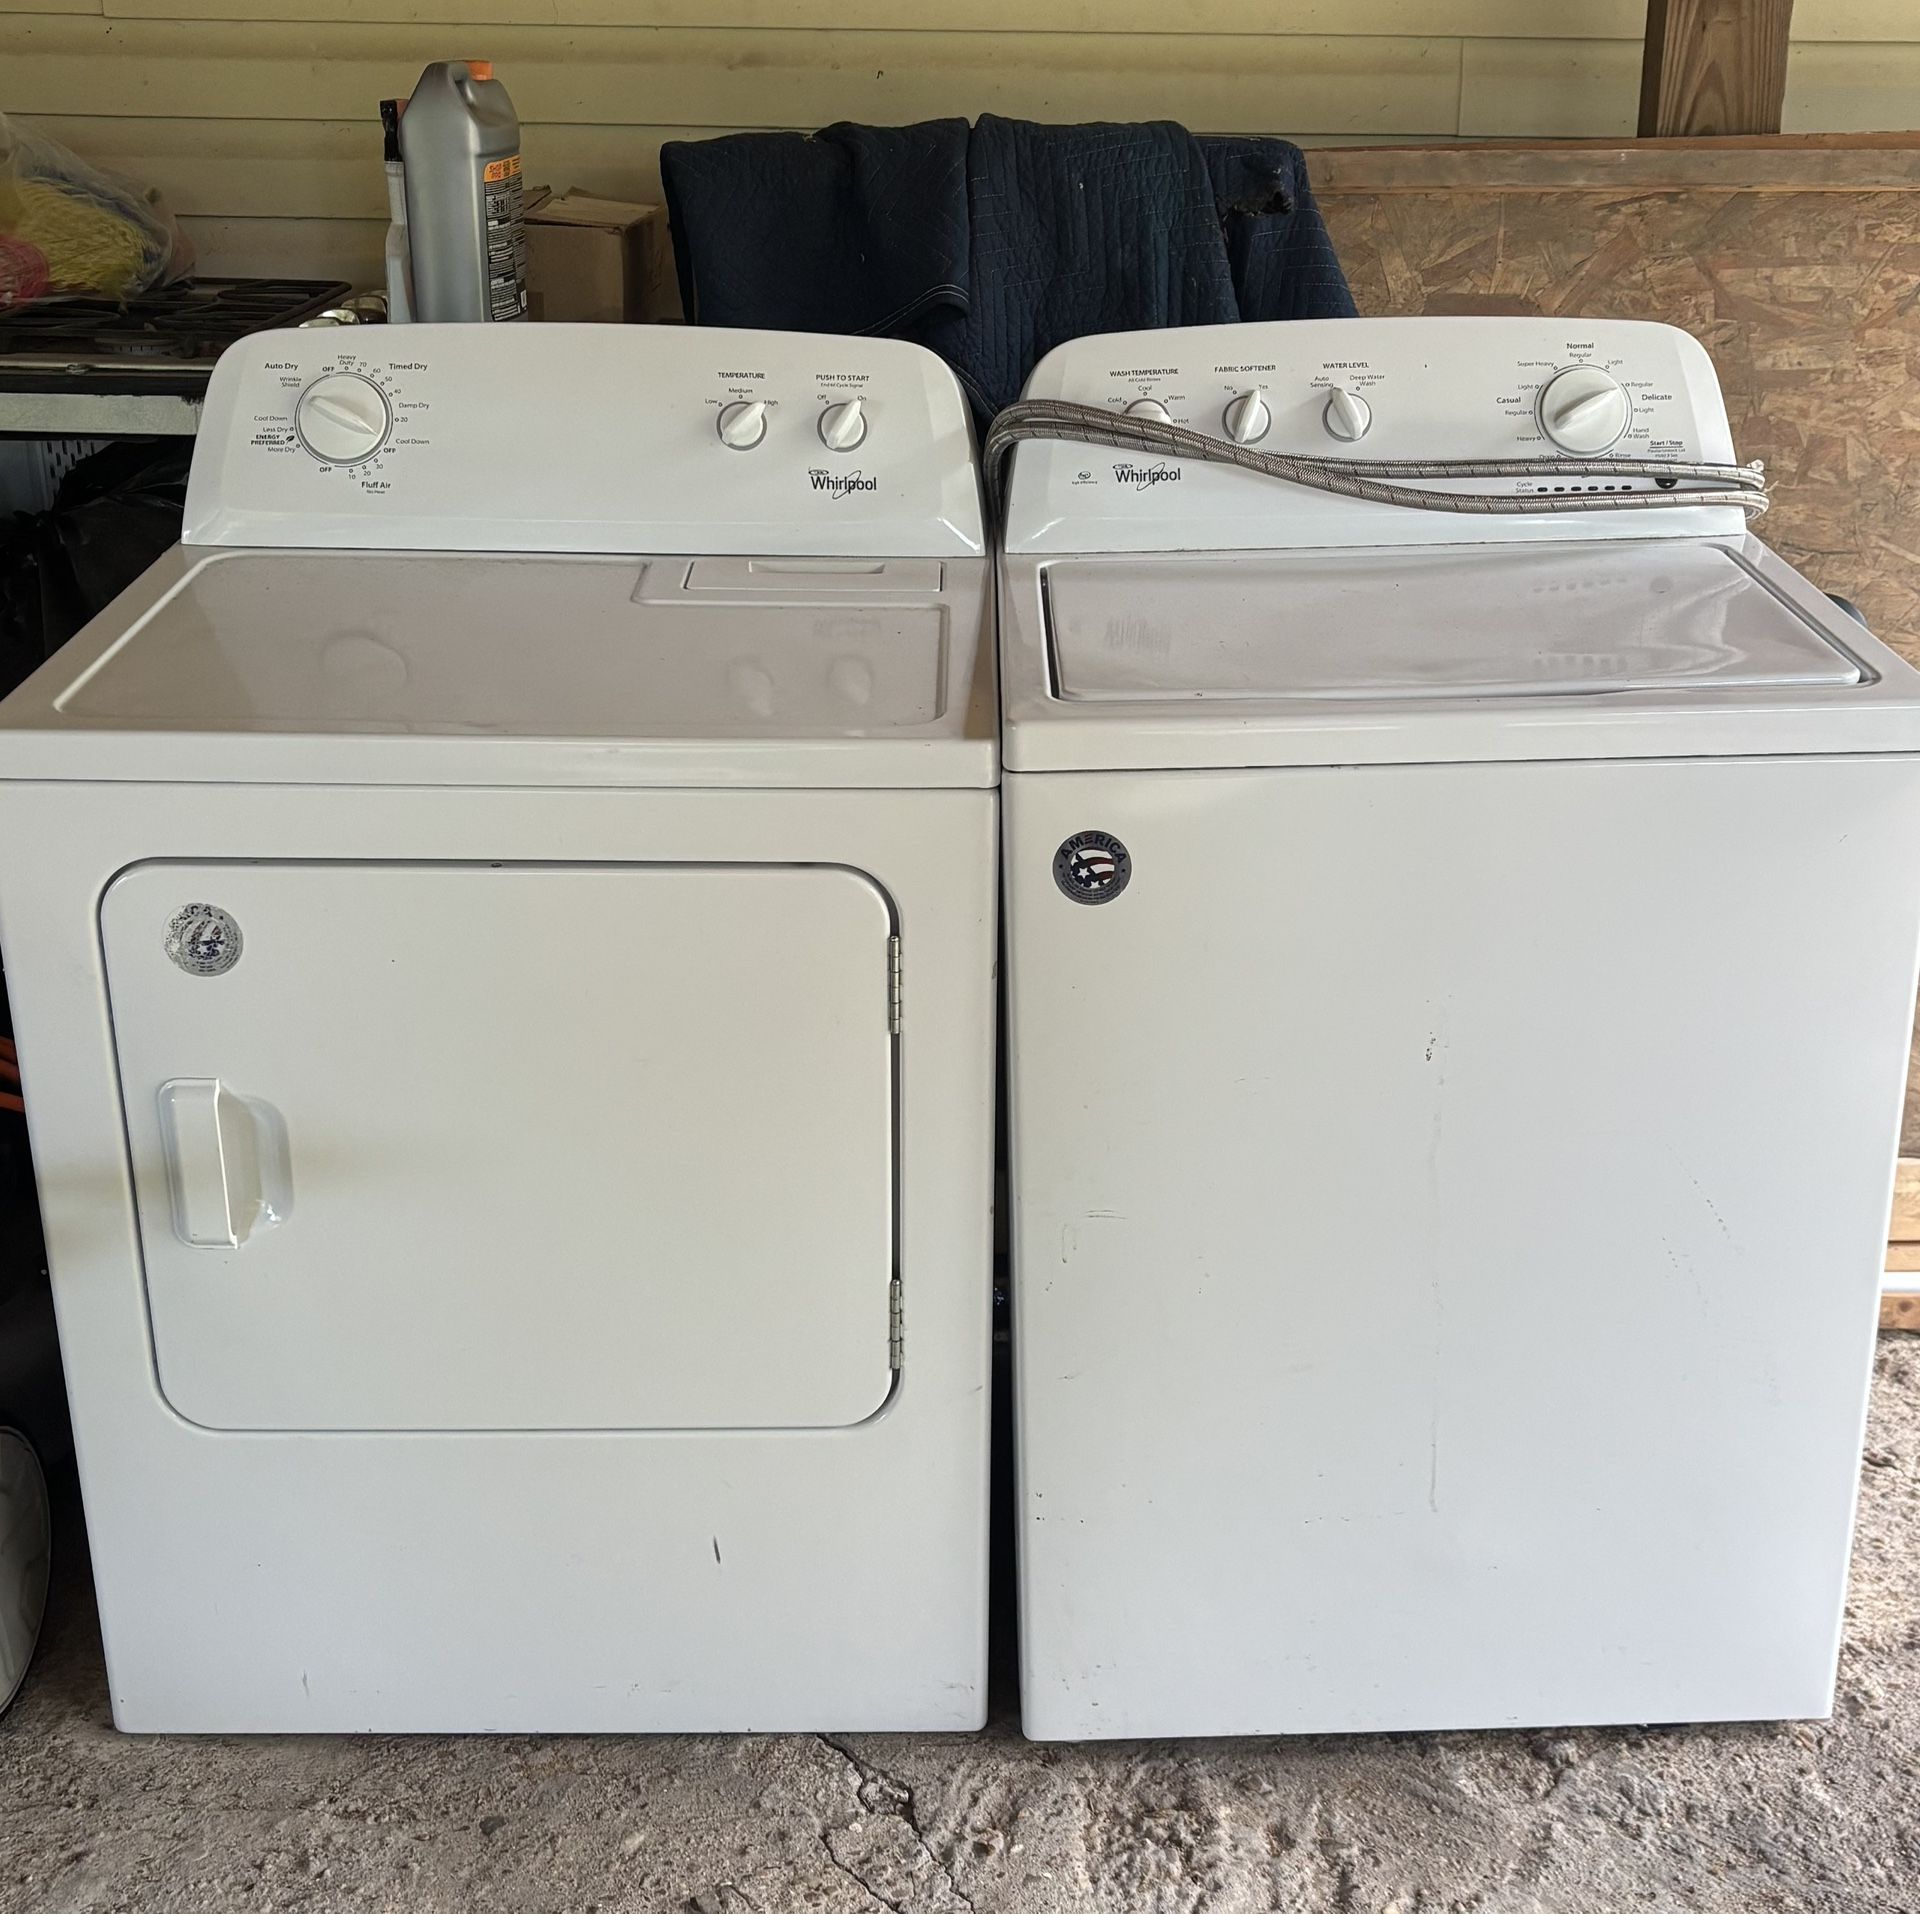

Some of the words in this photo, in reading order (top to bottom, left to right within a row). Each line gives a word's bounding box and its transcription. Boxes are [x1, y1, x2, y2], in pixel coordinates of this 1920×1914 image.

[284, 363, 299, 371] Dry
[414, 363, 428, 371] Dry
[1322, 362, 1348, 370] WATER
[718, 372, 766, 380] TEMPERATURE
[1131, 368, 1179, 376] TEMPERATURE
[847, 374, 870, 382] START
[284, 446, 296, 454] Dry
[1115, 468, 1181, 486] Whirlpool
[361, 481, 378, 489] Fluff
[379, 481, 391, 489] Air
[810, 476, 877, 494] Whirlpool
[1061, 833, 1127, 863] AMERICA
